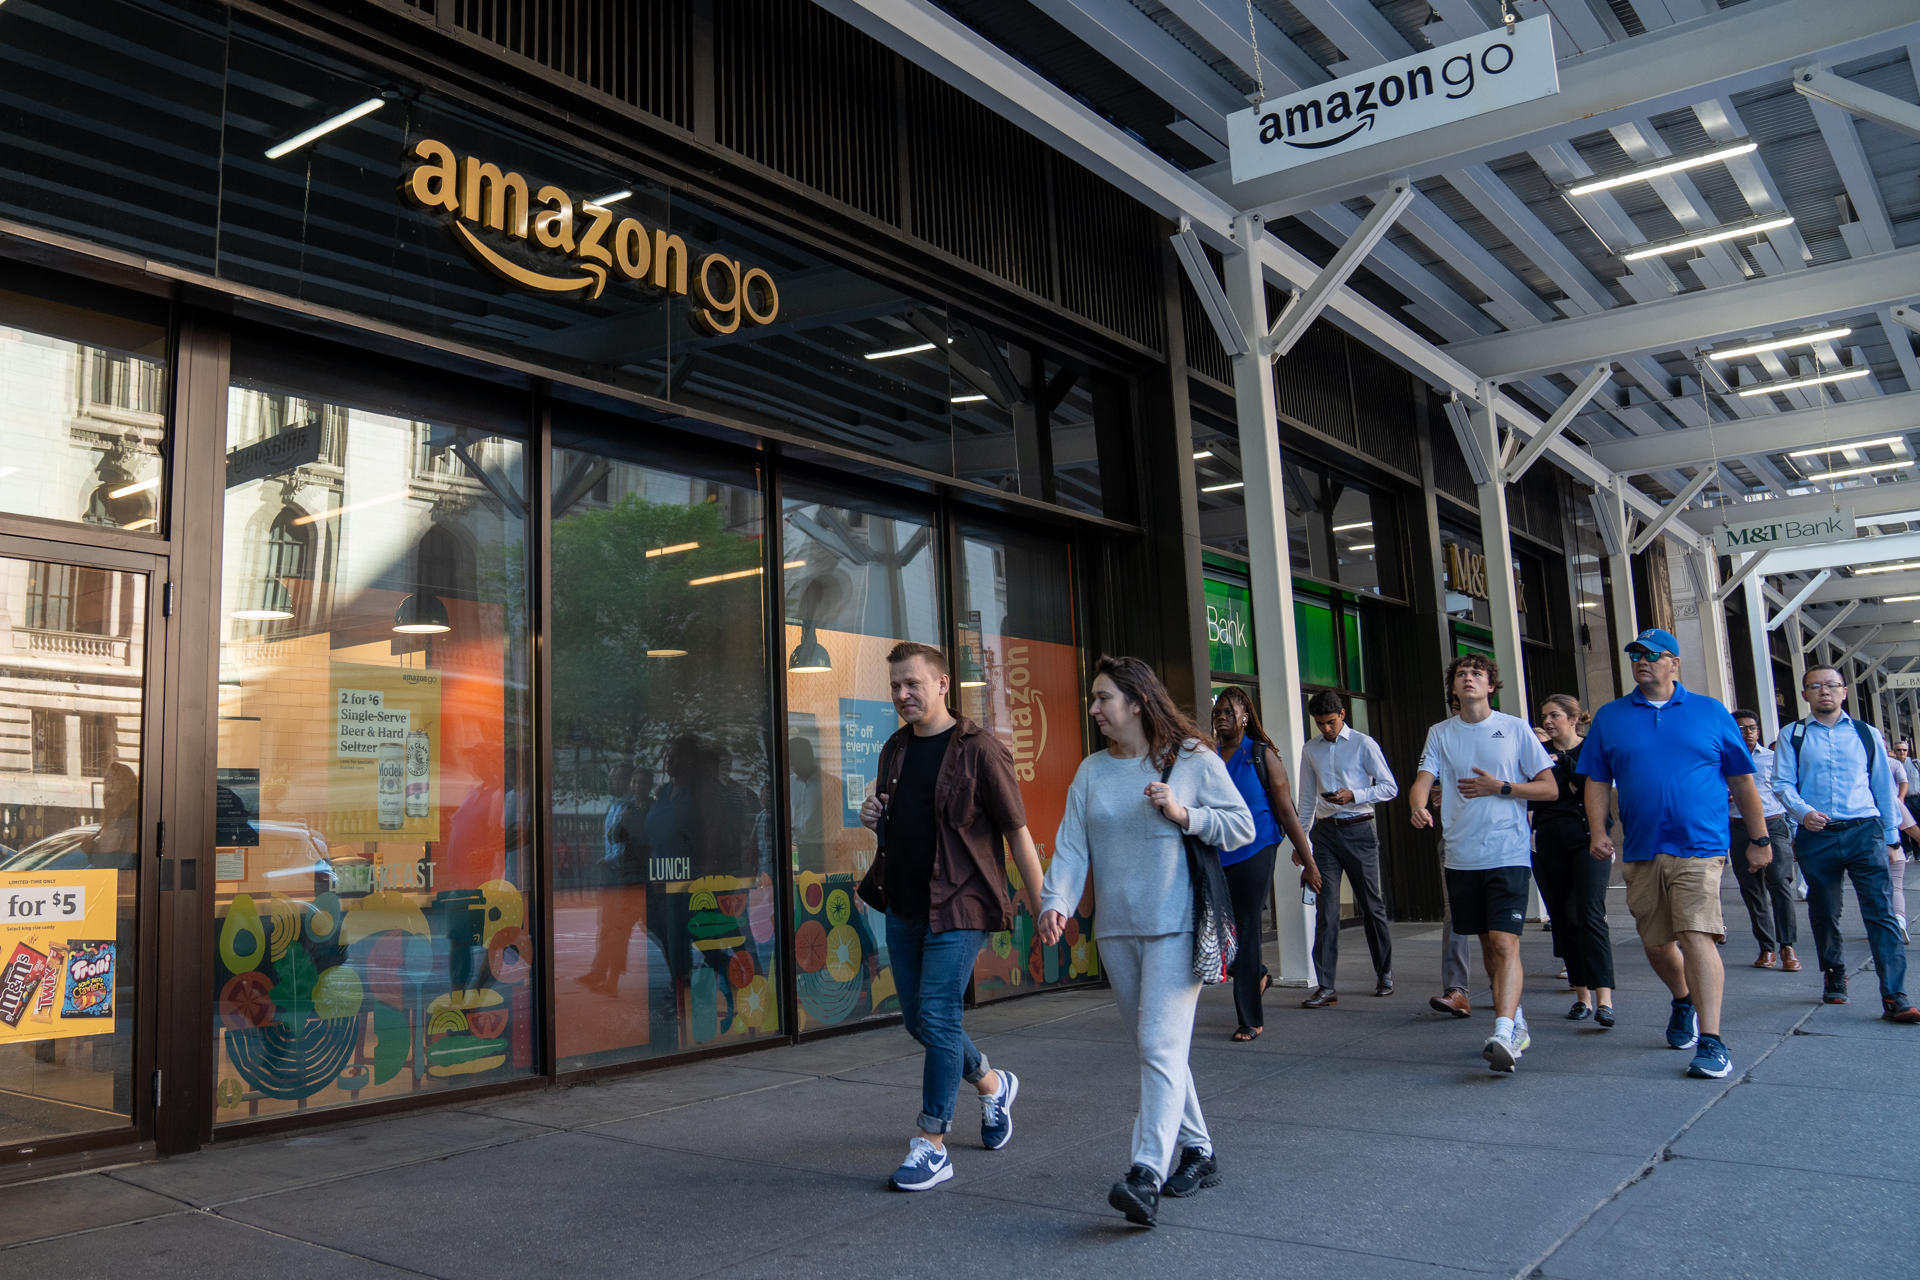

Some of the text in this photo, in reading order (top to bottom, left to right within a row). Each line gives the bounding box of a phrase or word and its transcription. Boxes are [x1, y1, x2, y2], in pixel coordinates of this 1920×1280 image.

[1259, 43, 1514, 146] amazon go
[405, 138, 779, 334] amazon go
[1727, 517, 1844, 547] M&T Bank
[1206, 605, 1247, 648] Bank
[341, 693, 379, 706] 2 for $6
[341, 708, 407, 723] Single-Serve
[1008, 646, 1037, 782] amazon
[341, 724, 404, 739] Beer & Hard
[860, 725, 874, 738] off
[340, 741, 378, 753] Seltzer
[846, 741, 870, 755] every
[649, 857, 690, 881] LUNCH
[8, 890, 77, 917] for $5
[71, 954, 112, 981] Trolli
[72, 981, 105, 999] Crawlers
